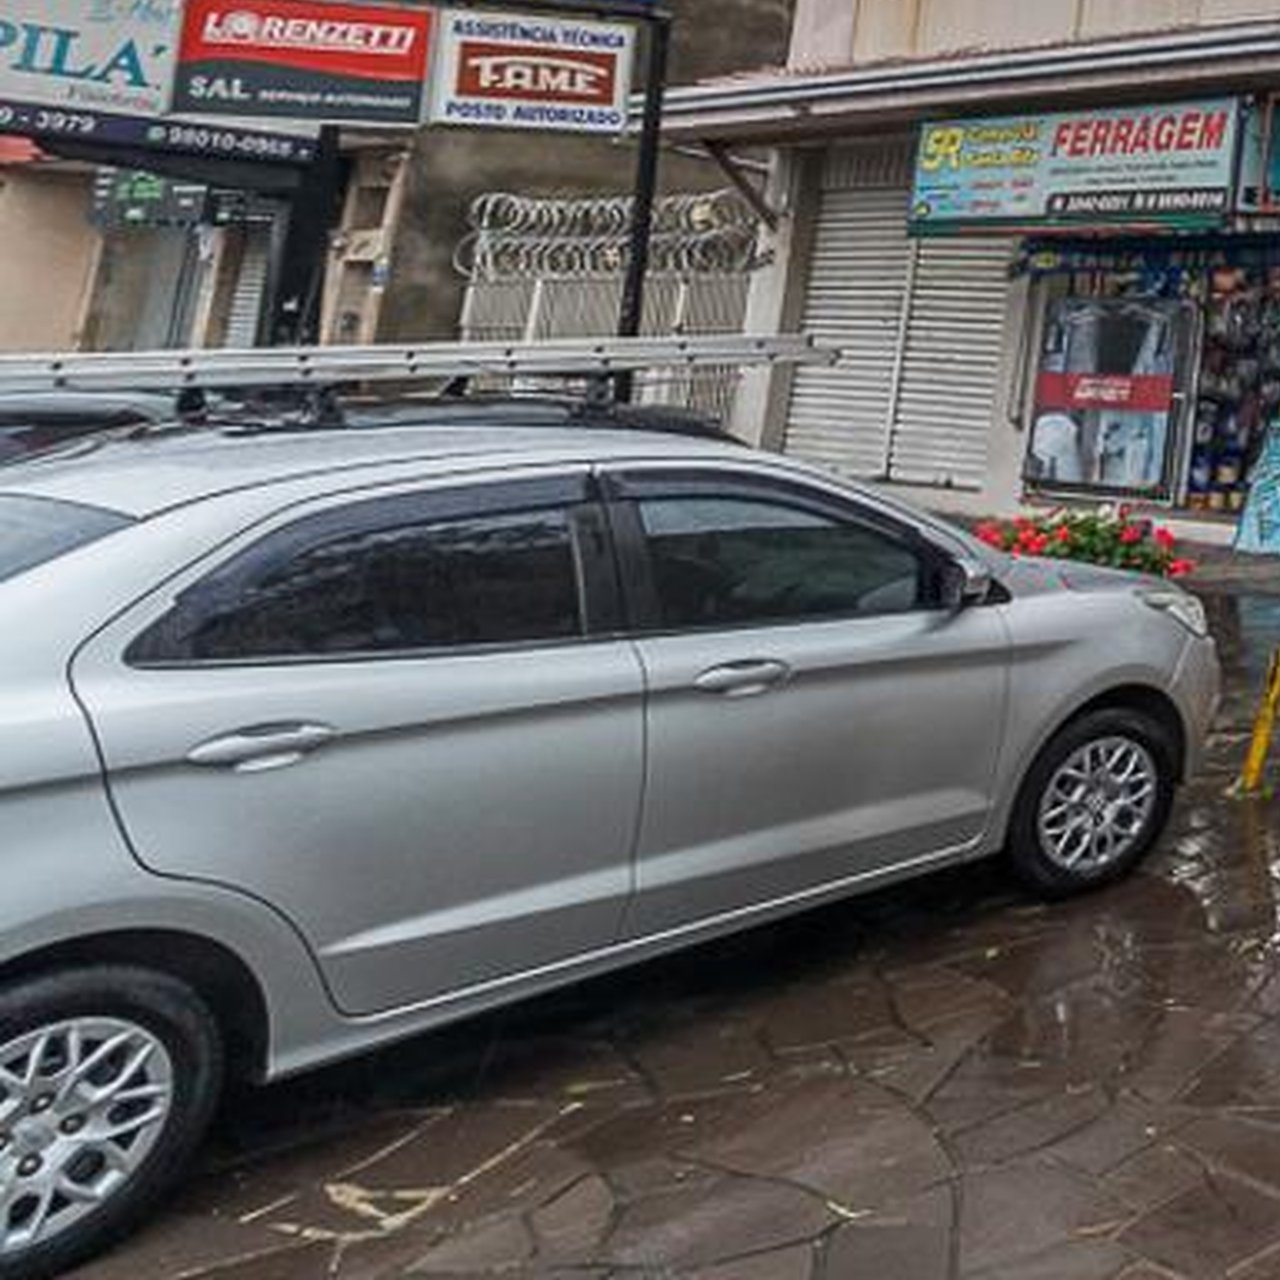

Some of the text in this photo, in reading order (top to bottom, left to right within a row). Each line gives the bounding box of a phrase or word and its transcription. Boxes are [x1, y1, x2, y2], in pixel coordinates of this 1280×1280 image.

[201, 10, 417, 56] LORENZETTI
[189, 76, 250, 100] SAL
[445, 102, 622, 126] POSTO AUTORIZADO
[1049, 110, 1230, 158] FERRAGEM
